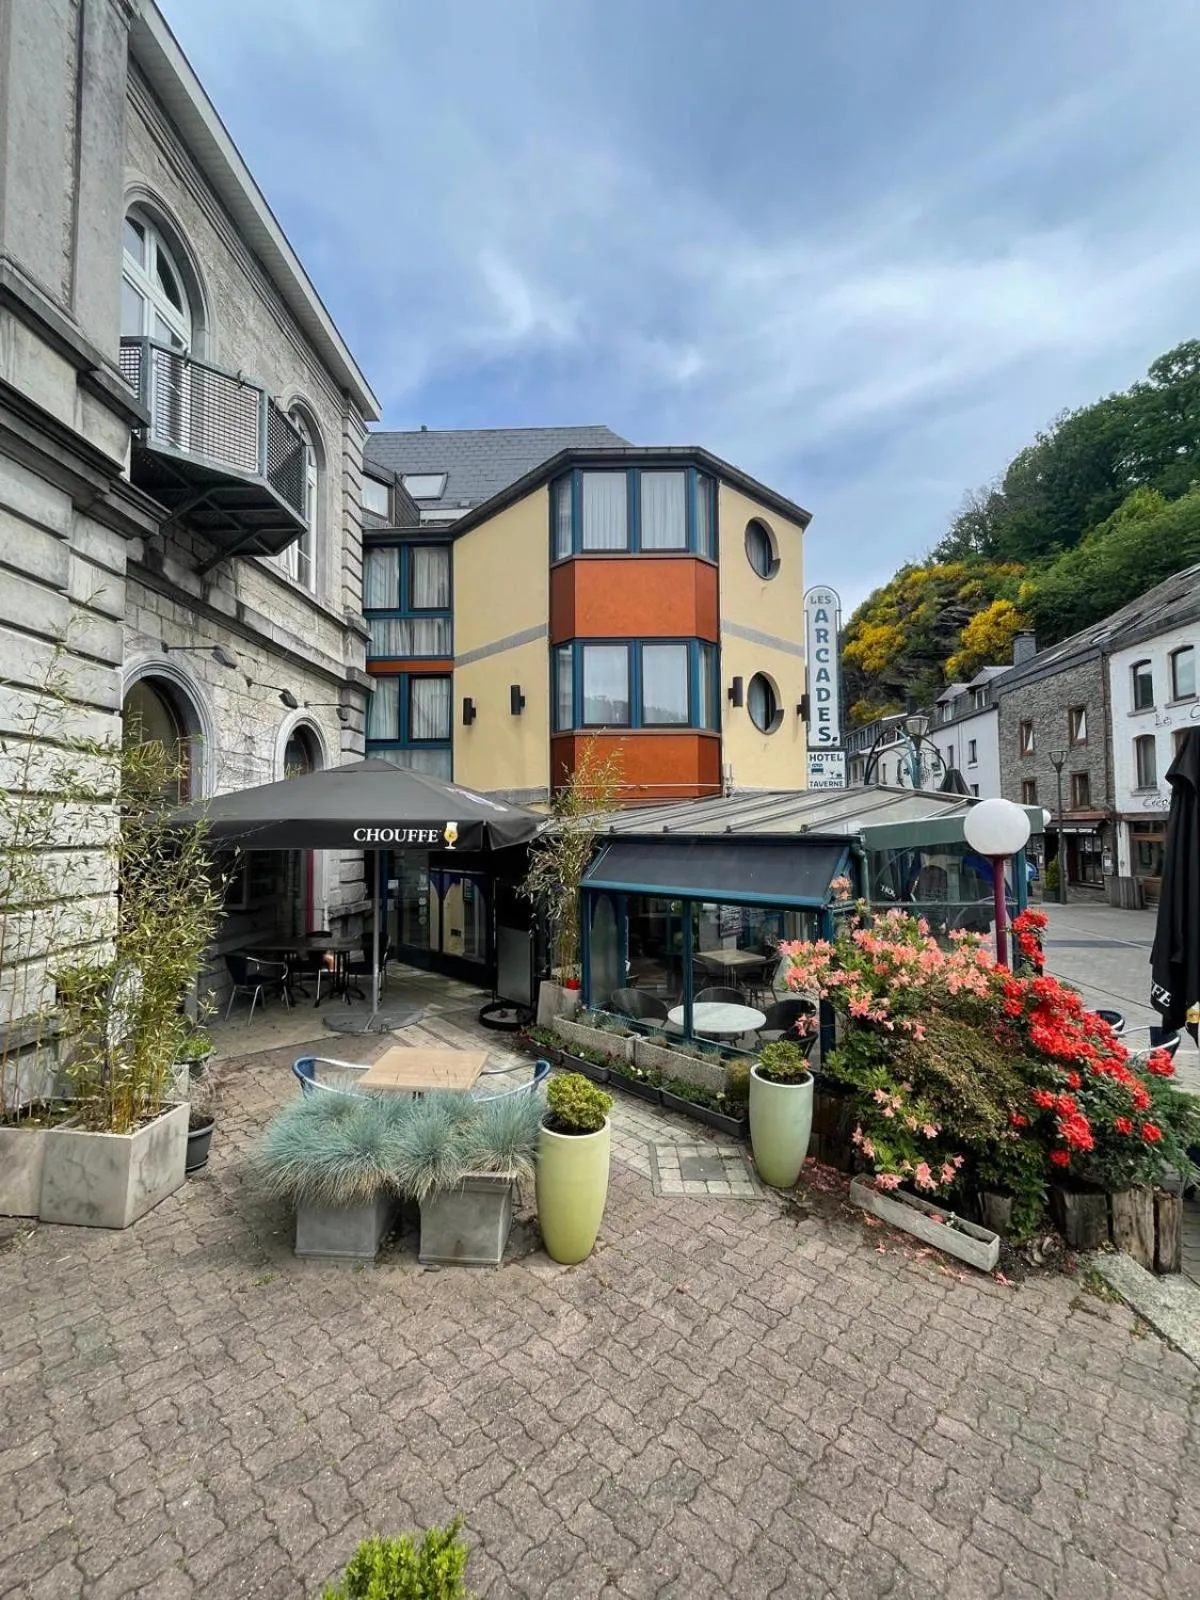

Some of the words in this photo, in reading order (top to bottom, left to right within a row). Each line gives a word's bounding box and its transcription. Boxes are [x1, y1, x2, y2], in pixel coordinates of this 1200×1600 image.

[810, 595, 831, 604] LES
[814, 608, 832, 743] ARCADES
[809, 753, 843, 762] HOTEL
[353, 828, 438, 842] CHOUFFE
